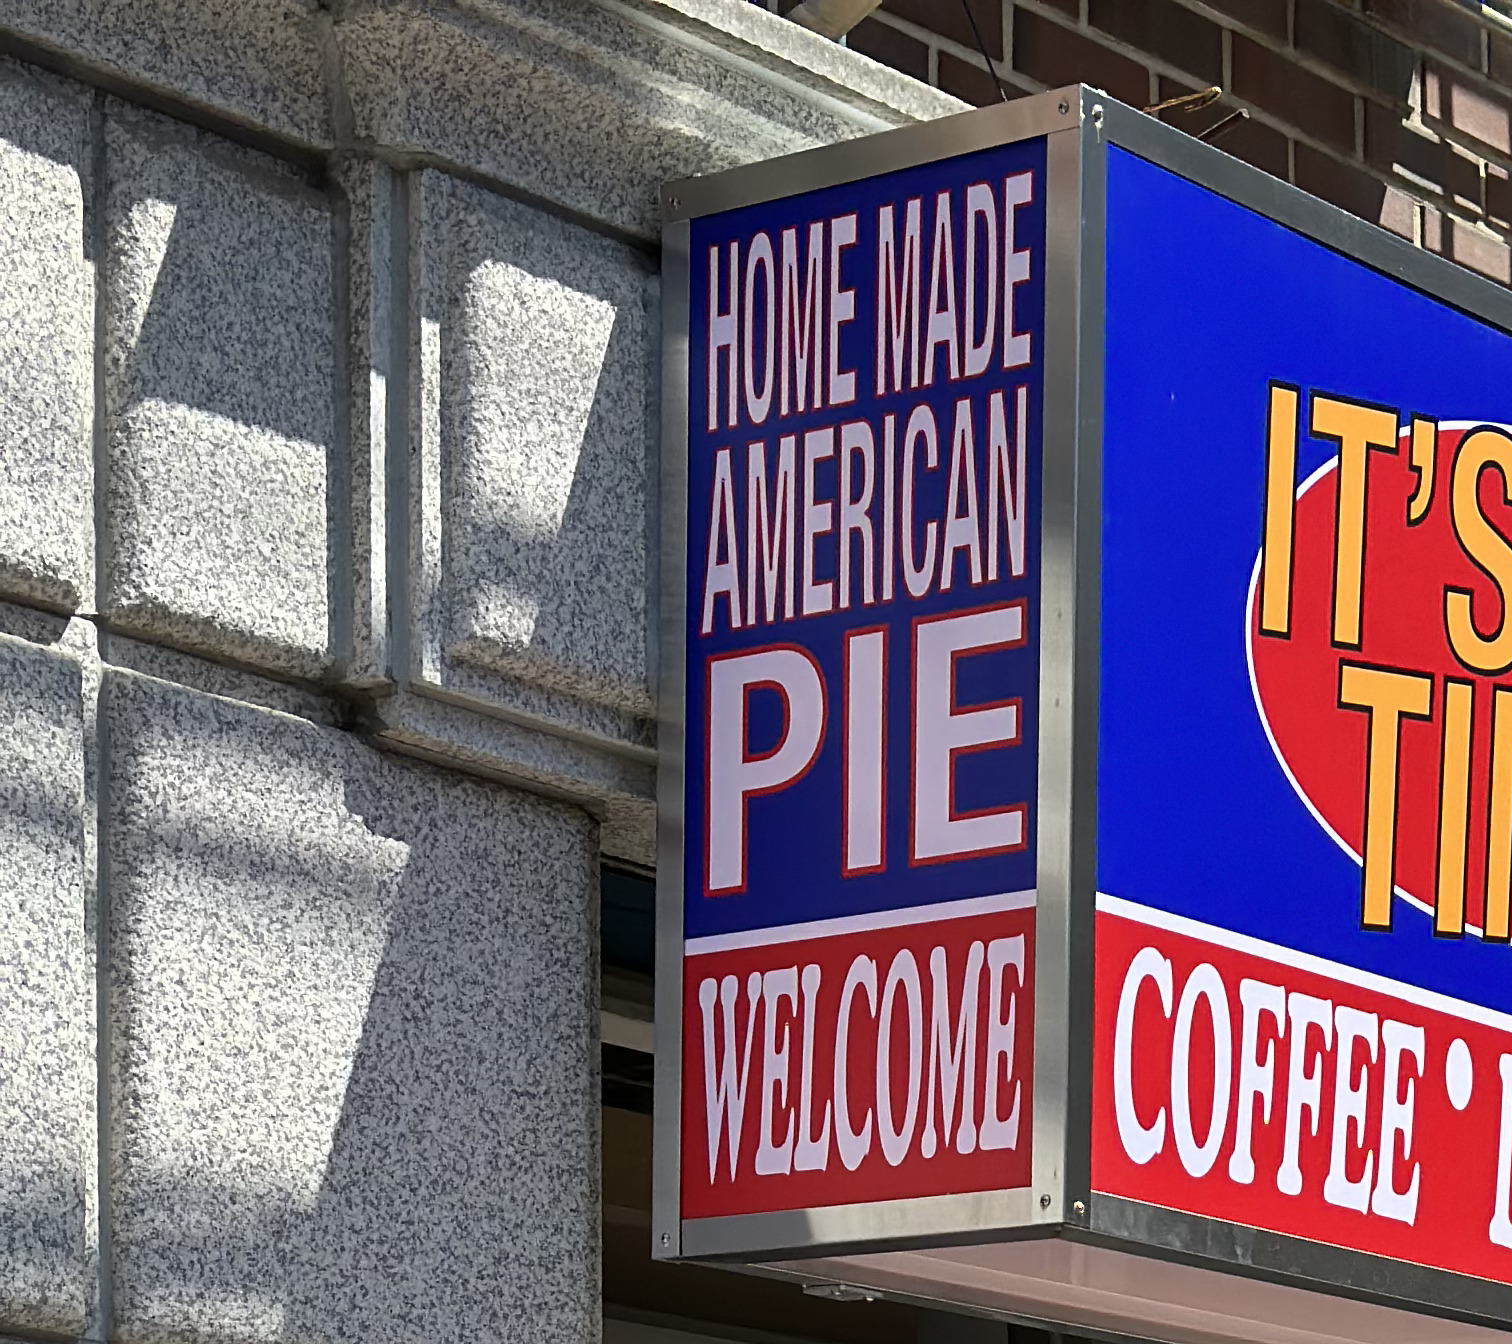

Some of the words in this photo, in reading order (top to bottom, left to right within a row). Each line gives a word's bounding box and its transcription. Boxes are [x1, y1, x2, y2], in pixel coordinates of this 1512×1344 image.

[708, 213, 857, 432] HOME
[876, 170, 1032, 395] MADE
[700, 384, 1029, 635] AMERICAN
[703, 603, 1027, 897] PIE
[698, 933, 1026, 1186] WELCOME
[1114, 946, 1426, 1226] COFFEE
